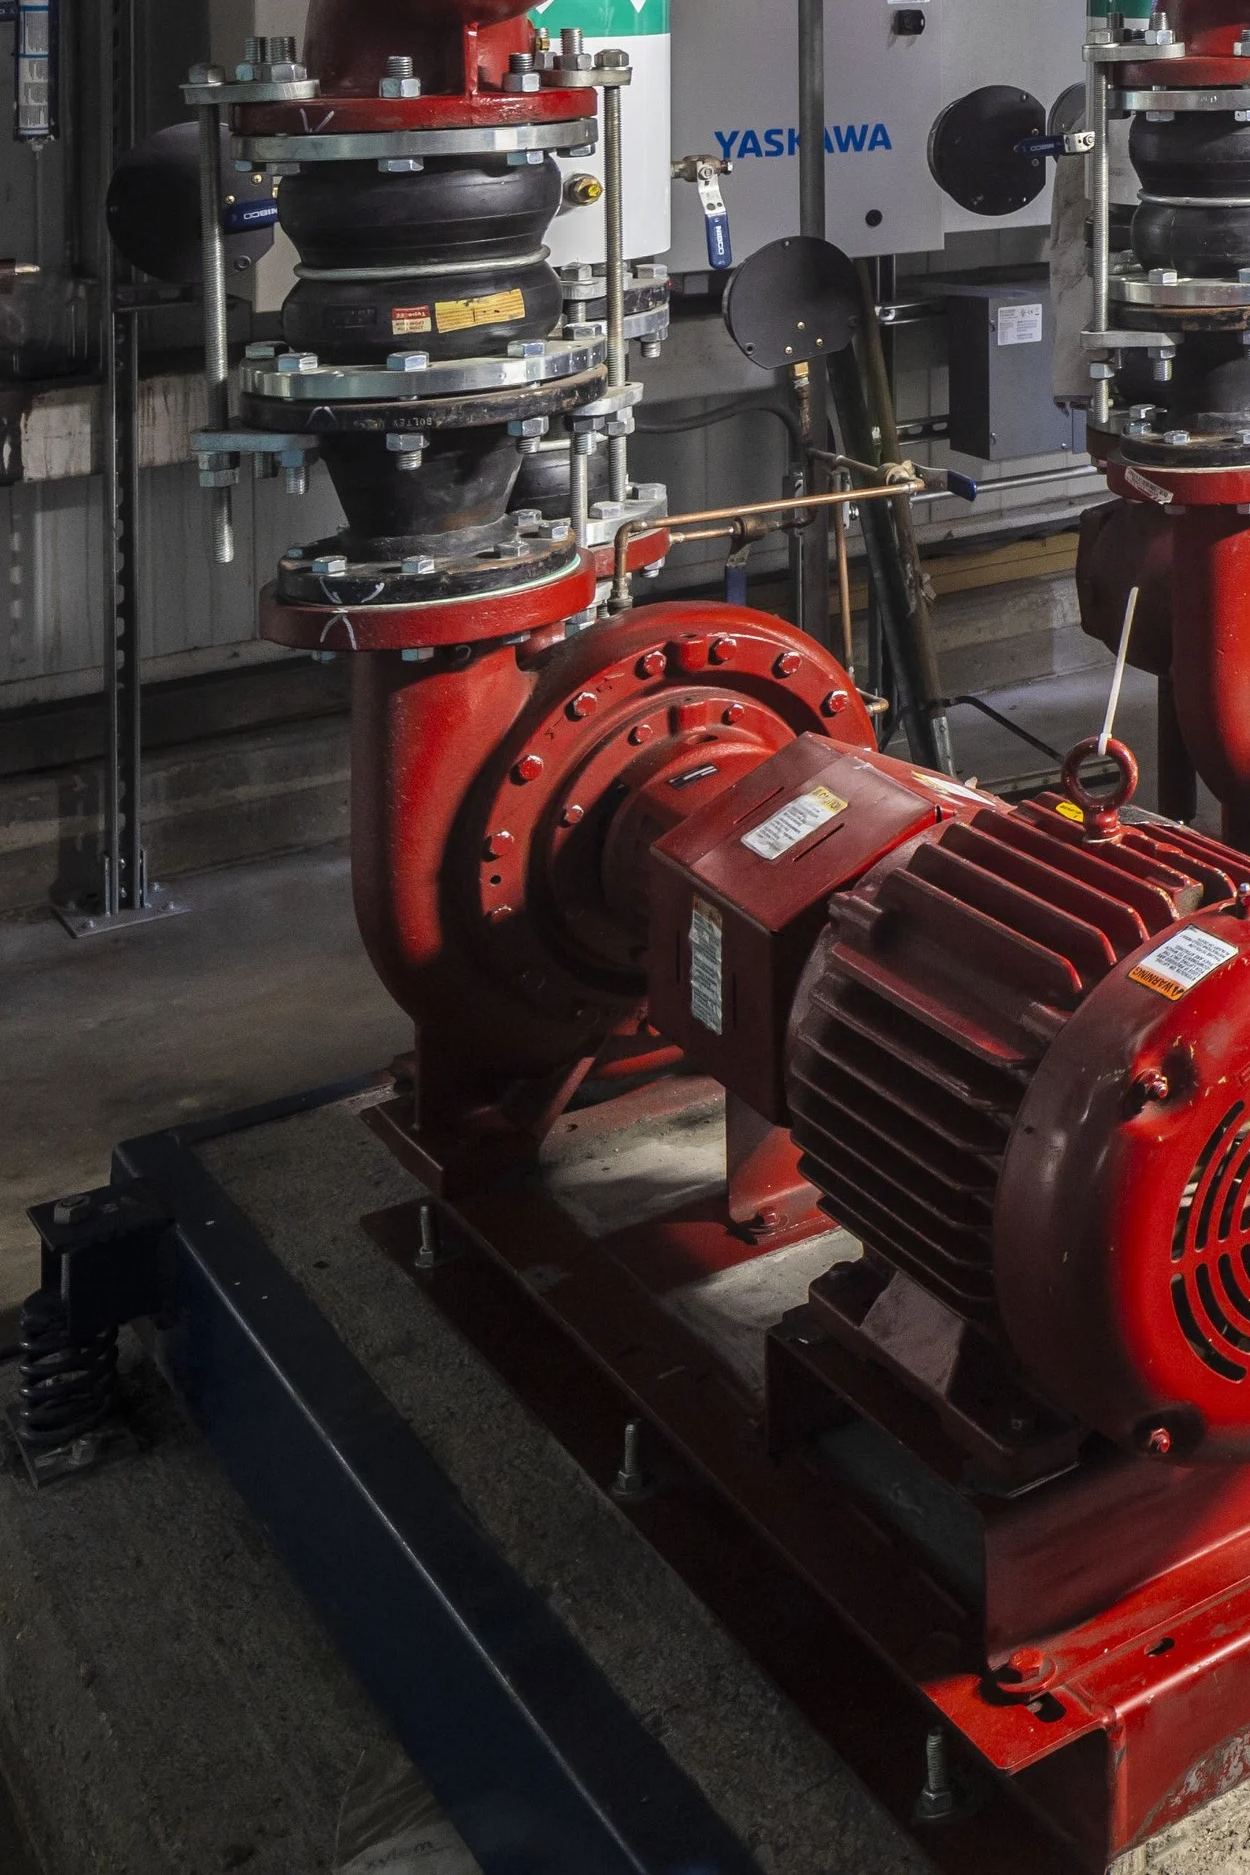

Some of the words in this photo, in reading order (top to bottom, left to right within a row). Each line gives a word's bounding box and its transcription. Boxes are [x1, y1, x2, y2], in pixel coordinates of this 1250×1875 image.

[243, 207, 278, 220] NIBCO
[716, 226, 725, 255] NIBCO
[1143, 966, 1185, 992] WARNING
